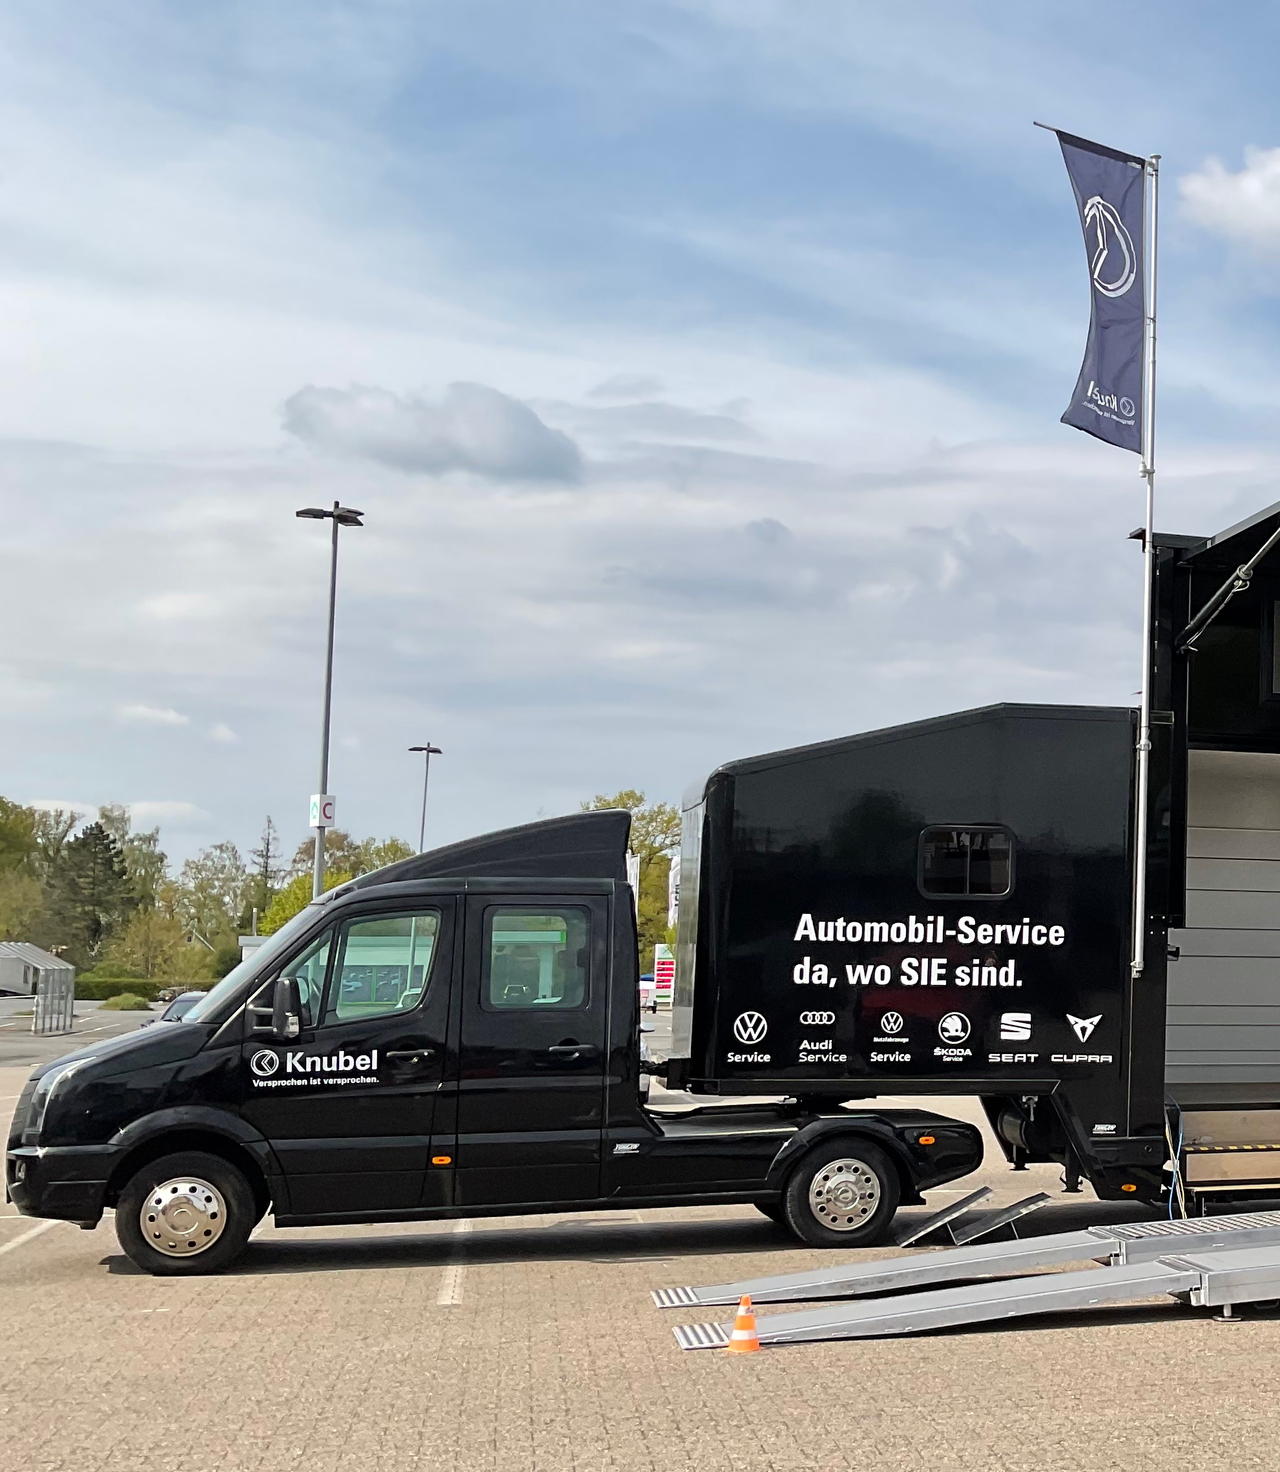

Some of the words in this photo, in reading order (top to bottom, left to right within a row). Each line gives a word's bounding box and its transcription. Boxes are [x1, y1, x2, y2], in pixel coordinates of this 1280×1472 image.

[322, 801, 333, 820] C
[793, 913, 1066, 946] Automobil-Service
[793, 956, 838, 988] da,
[845, 964, 892, 986] wo
[900, 957, 948, 986] SIE
[955, 959, 1023, 987] sind.
[799, 1039, 833, 1050] Audi
[870, 1051, 912, 1062] Service
[933, 1046, 973, 1056] ŠKODA
[286, 1049, 378, 1073] Knubel
[727, 1052, 771, 1062] Service
[798, 1052, 848, 1062] Service
[988, 1053, 1039, 1063] SEAT
[1051, 1054, 1113, 1063] CUPRA
[252, 1078, 308, 1088] Versprochen
[309, 1077, 321, 1085] ist
[323, 1075, 380, 1086] versprochen.
